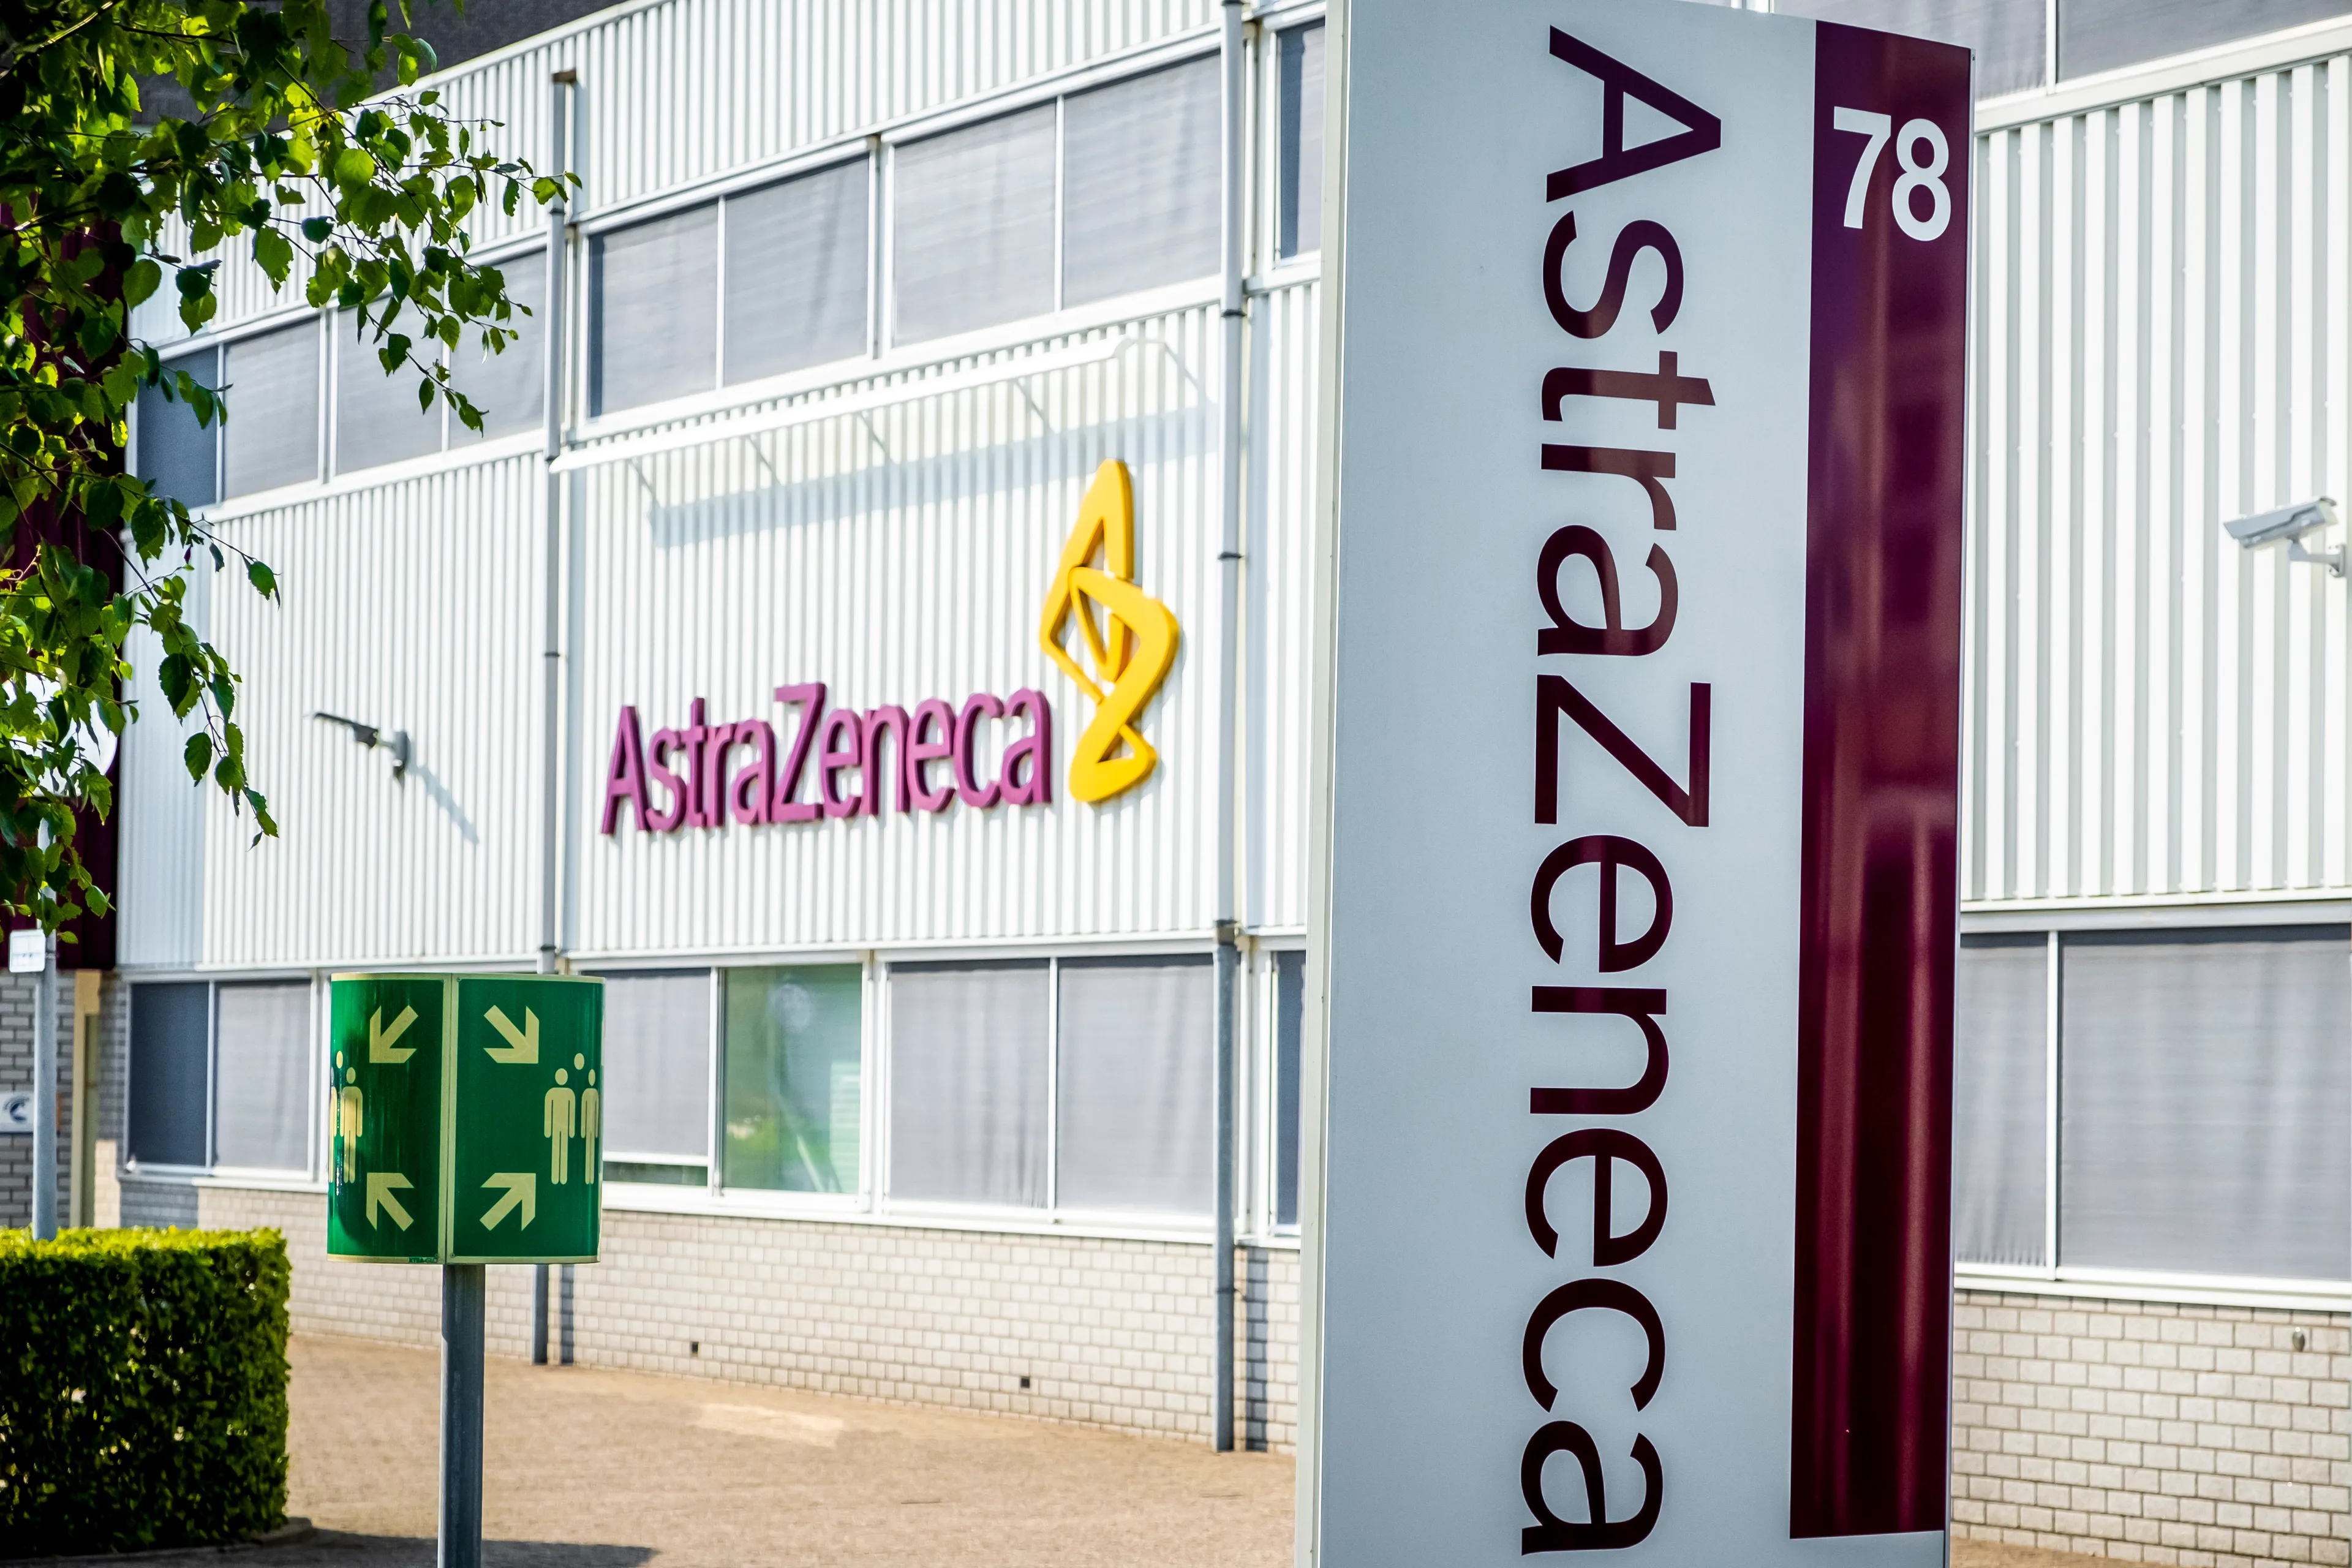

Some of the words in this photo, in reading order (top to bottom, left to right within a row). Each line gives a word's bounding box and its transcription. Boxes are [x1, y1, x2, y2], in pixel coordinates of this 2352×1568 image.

[1834, 106, 1951, 241] 78
[601, 682, 1052, 835] AstraZeneca
[1521, 24, 1722, 1556] AstraZeneca
